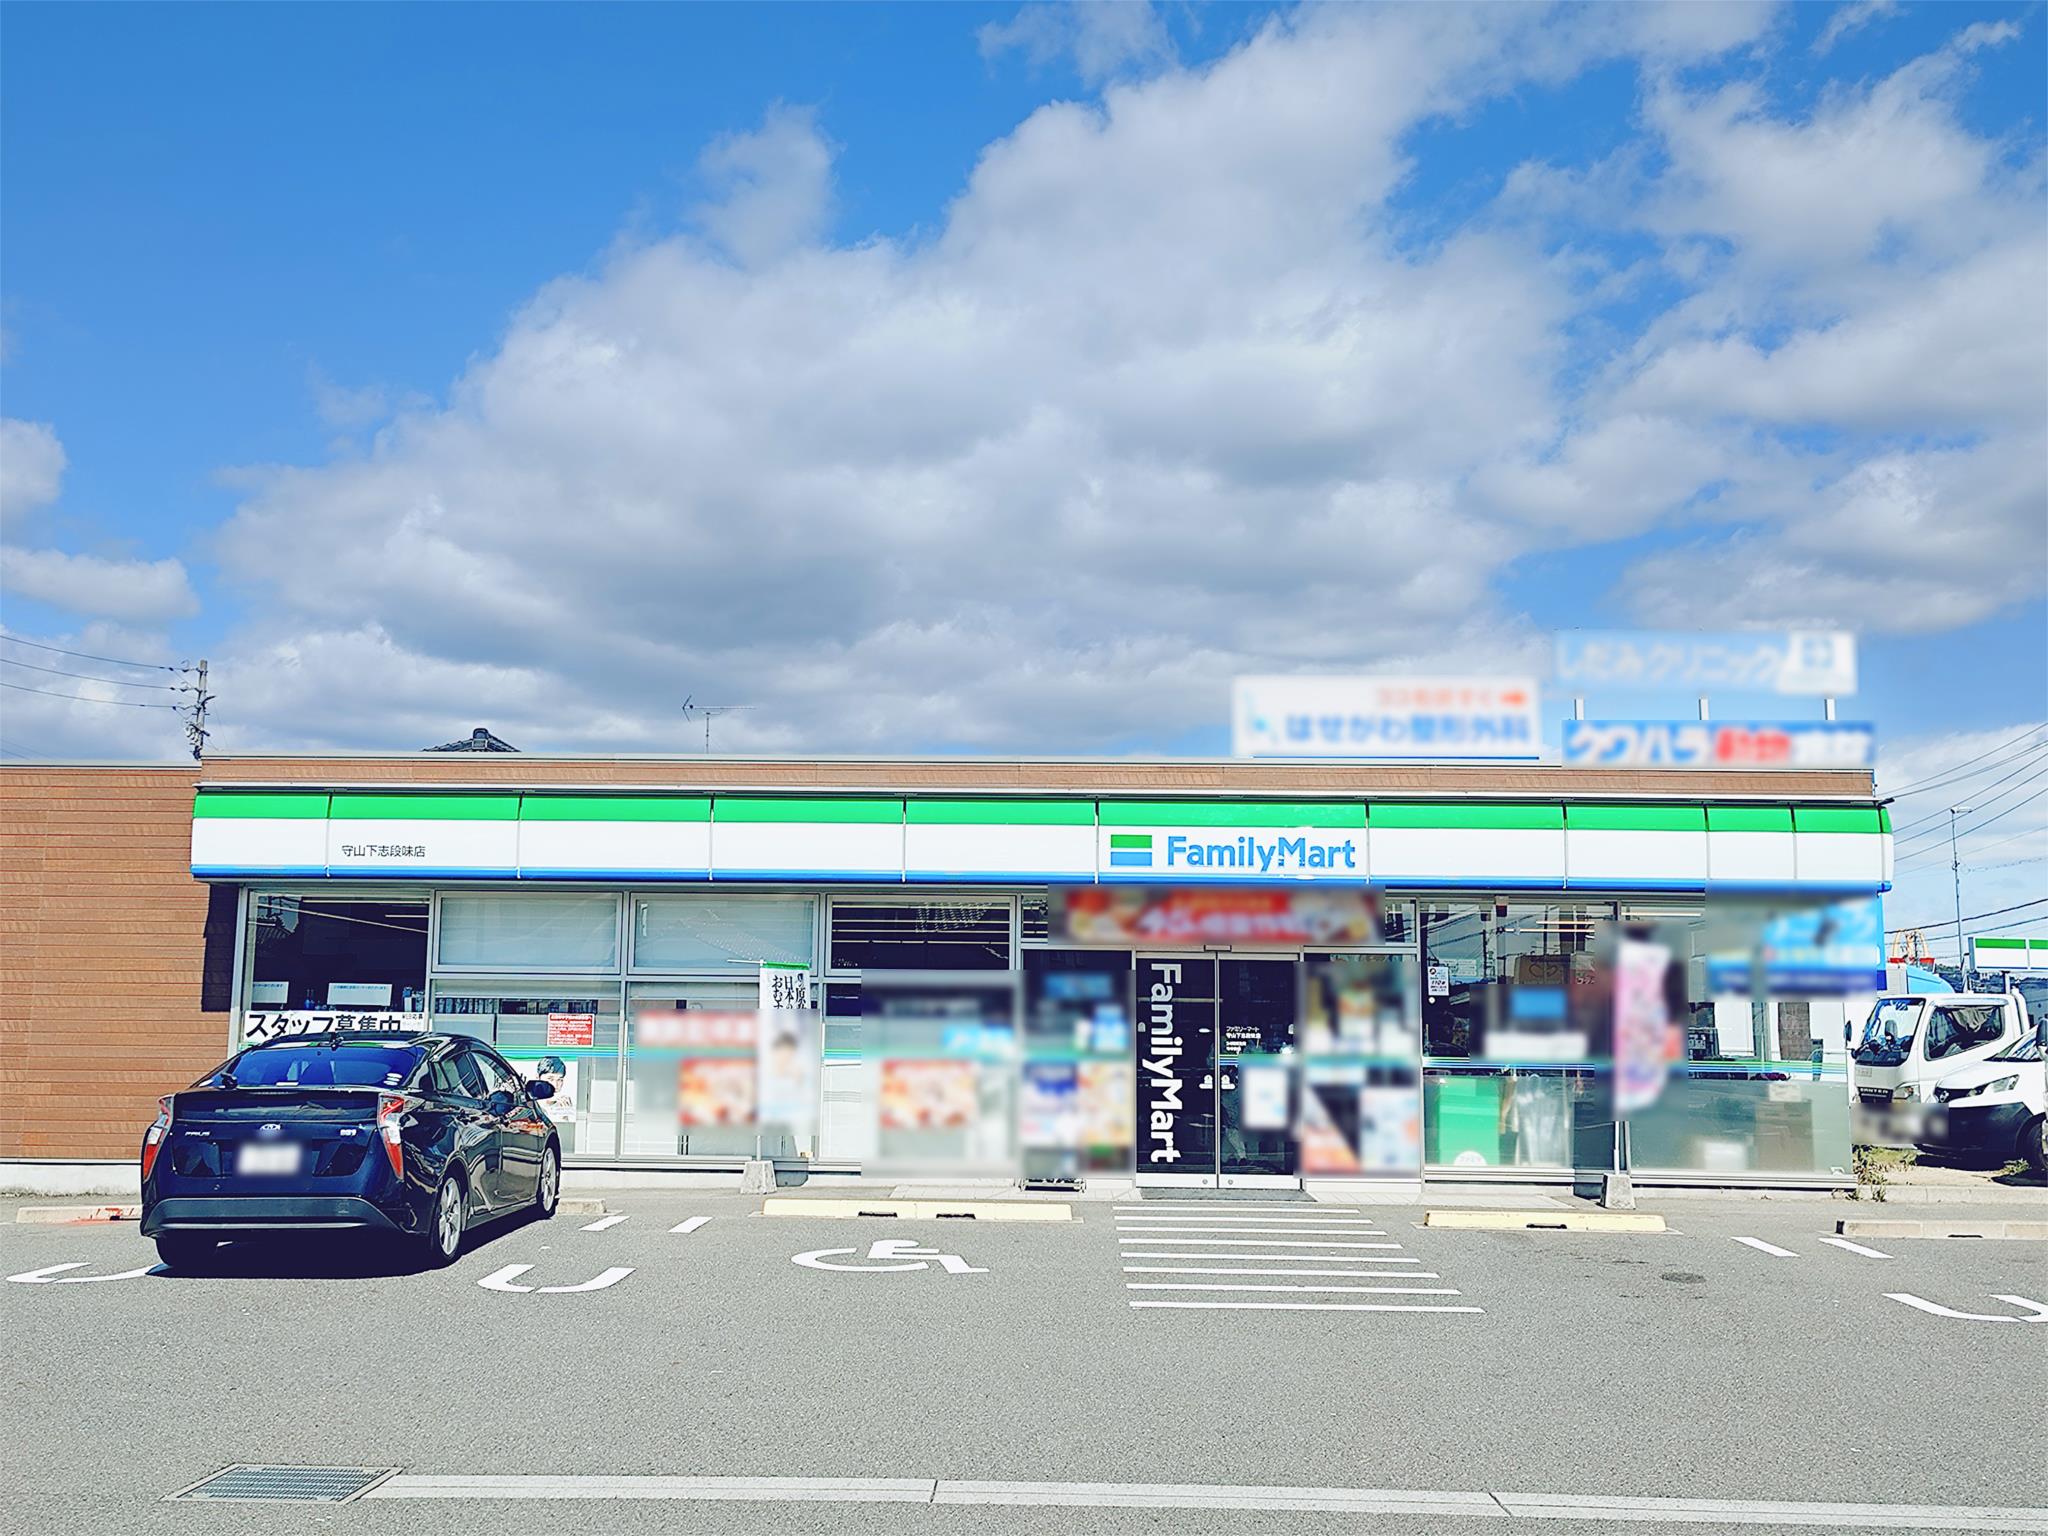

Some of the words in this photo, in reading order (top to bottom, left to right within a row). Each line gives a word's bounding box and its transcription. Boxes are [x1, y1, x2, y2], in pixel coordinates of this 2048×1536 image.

[341, 844, 426, 858] 守山下志段味店
[1167, 835, 1356, 872] FamilyMart
[1142, 963, 1183, 1163] FamilyMart
